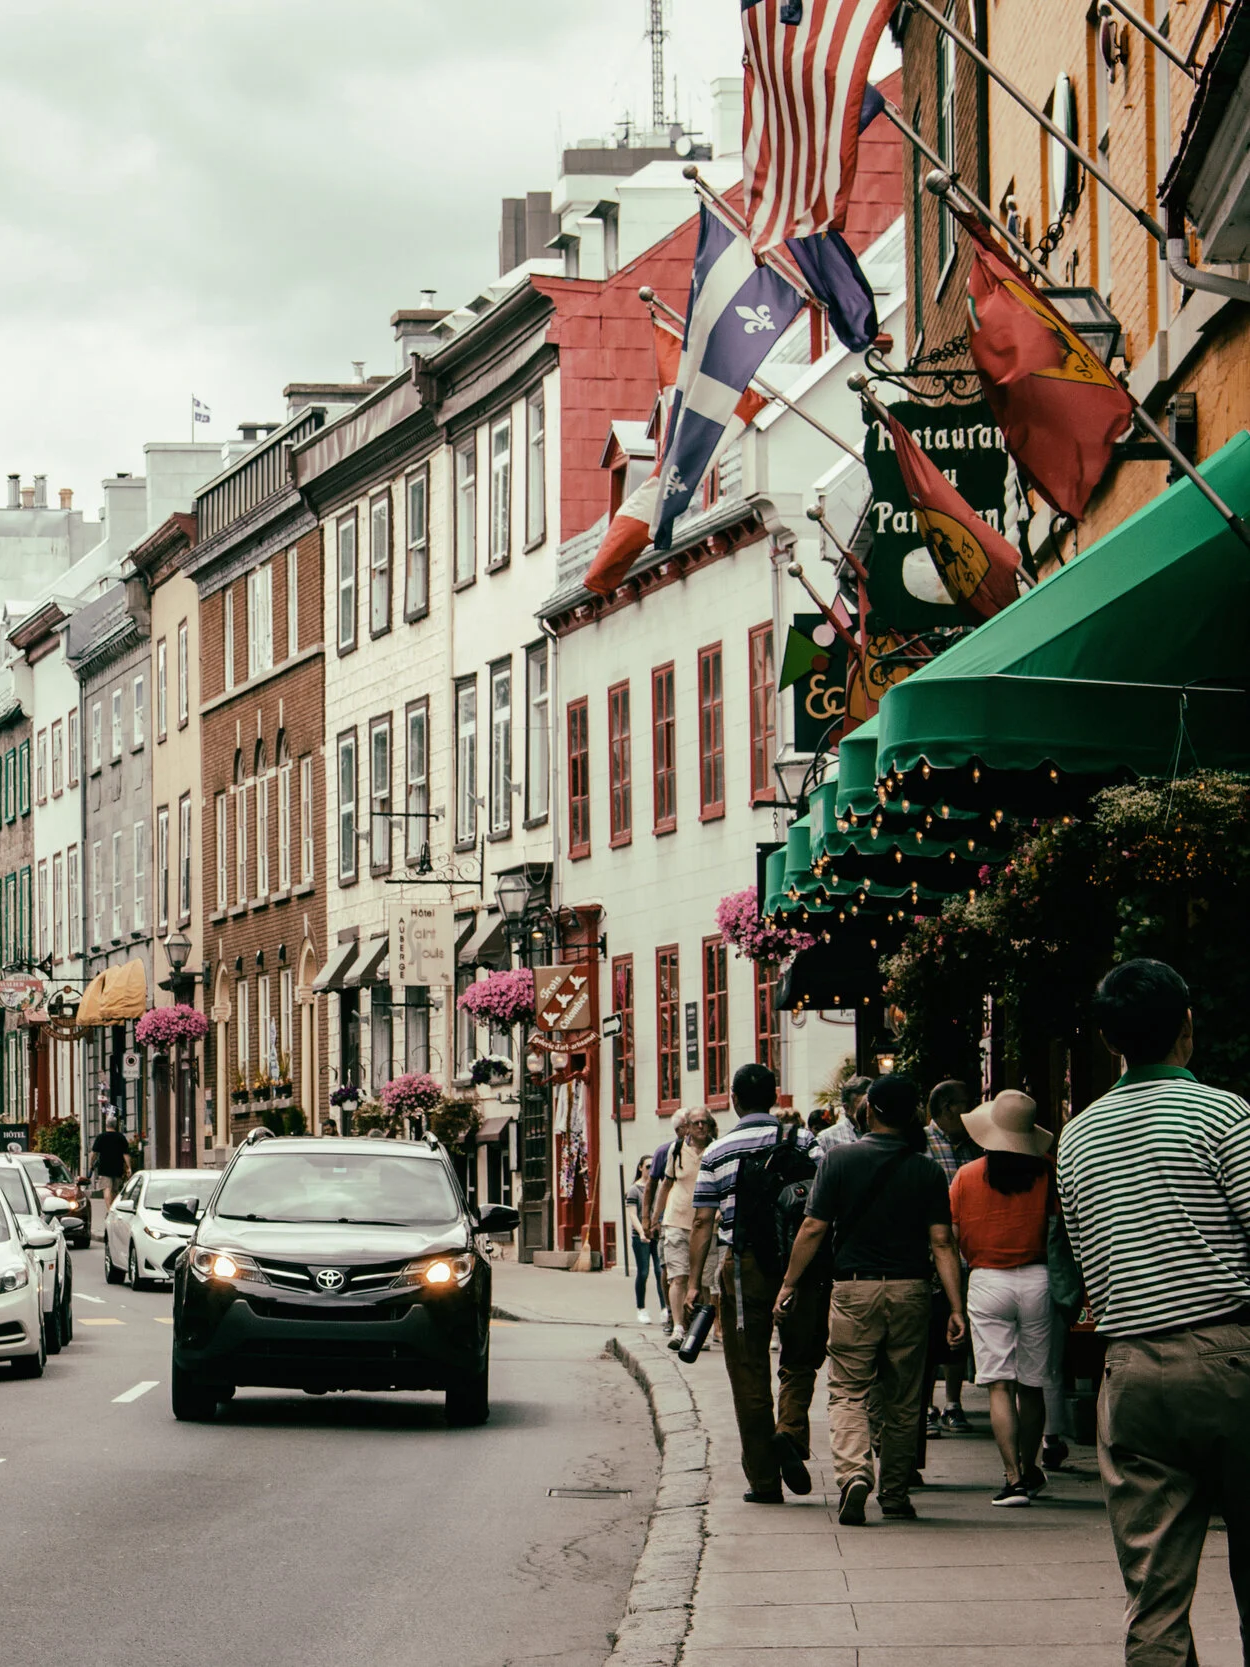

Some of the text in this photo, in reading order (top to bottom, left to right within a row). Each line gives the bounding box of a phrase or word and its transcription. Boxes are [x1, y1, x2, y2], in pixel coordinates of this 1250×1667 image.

[410, 908, 436, 918] Hôtel
[398, 916, 406, 979] AUBERGE
[539, 975, 562, 999] Trois
[559, 992, 589, 1029] Colombes
[3, 1130, 26, 1139] HÔTEL
